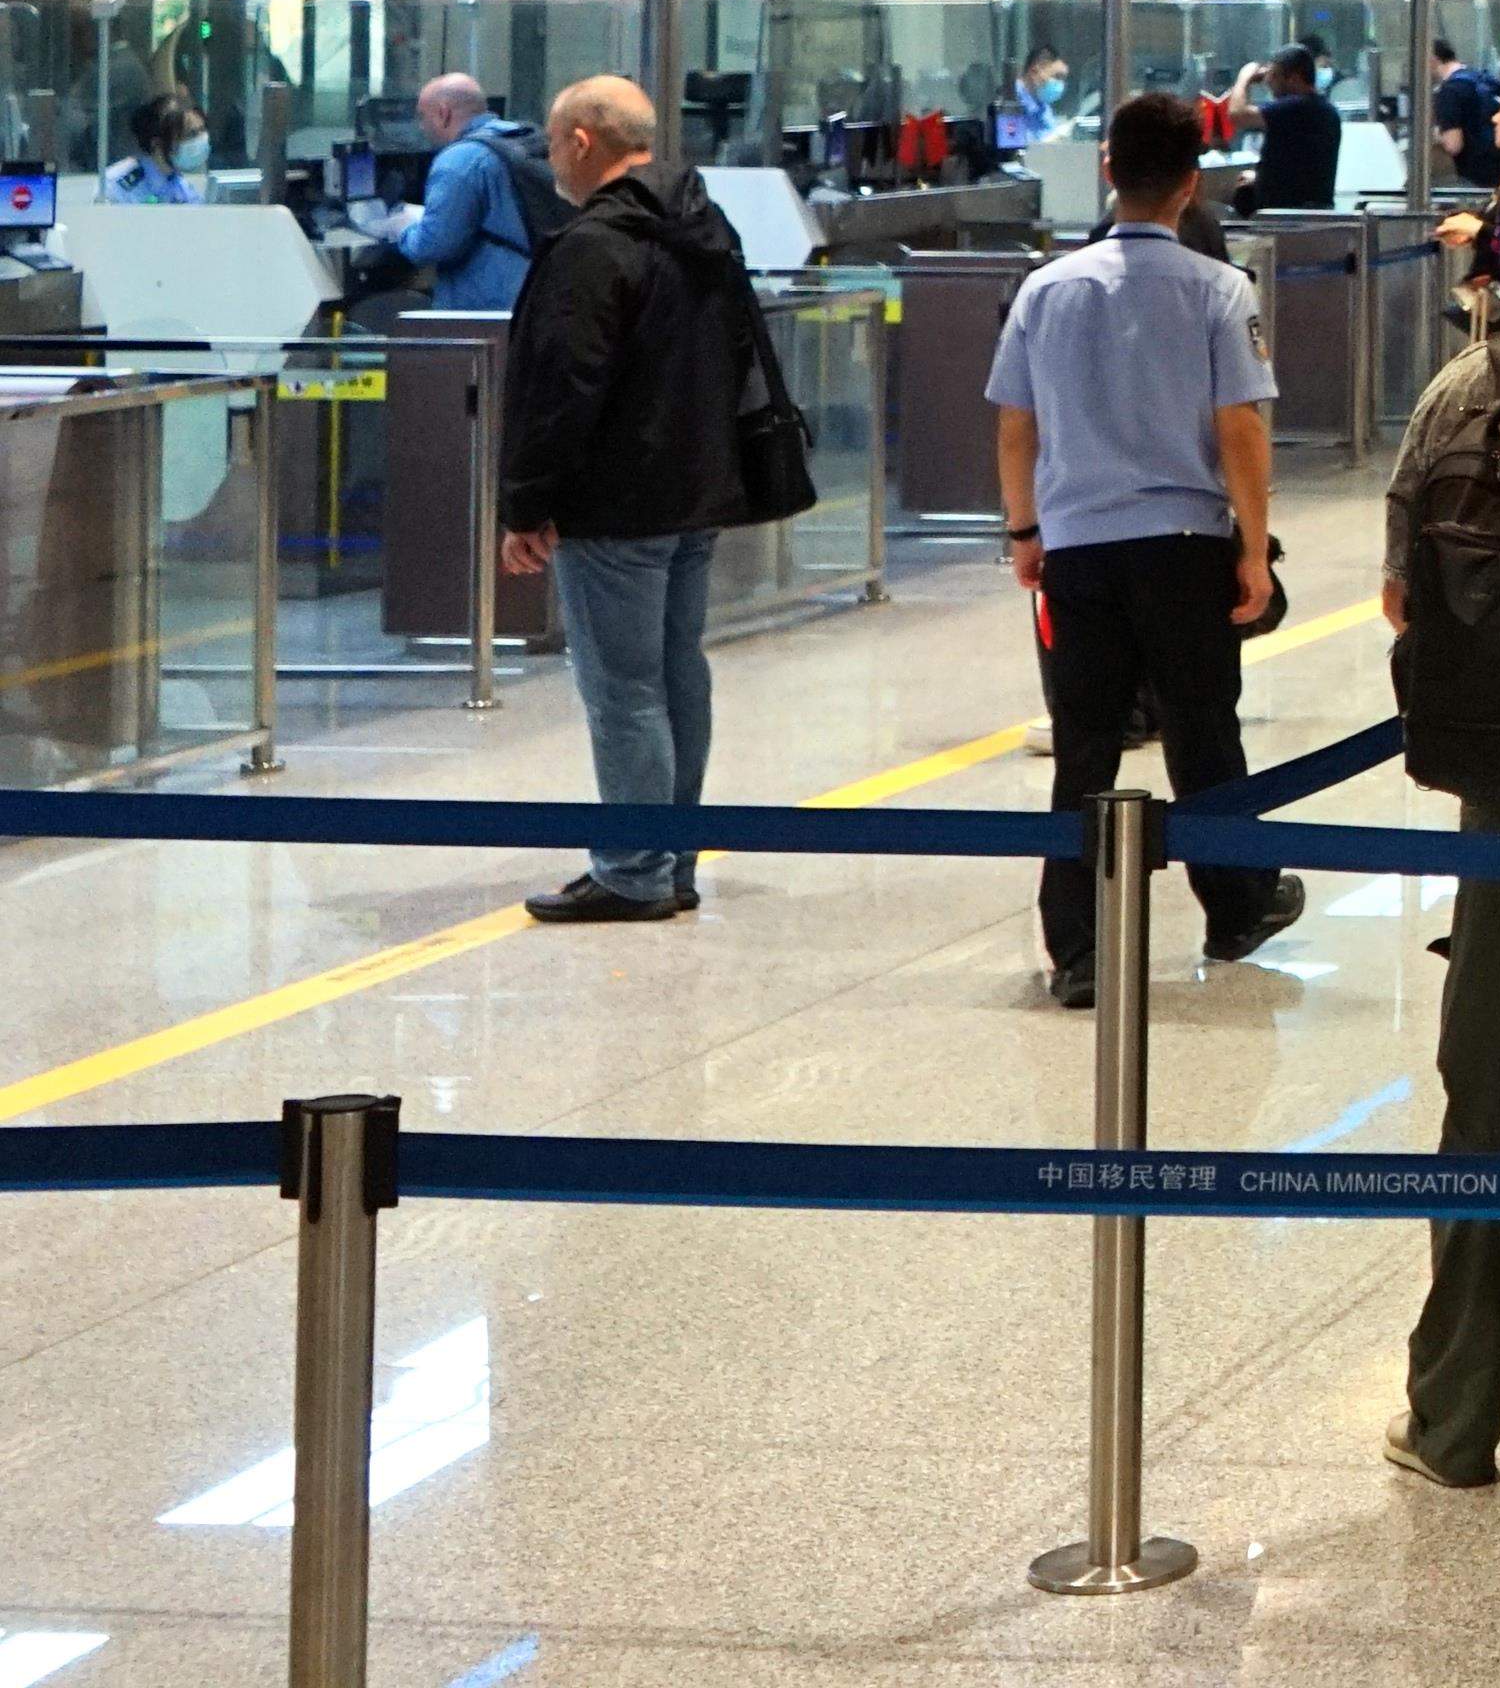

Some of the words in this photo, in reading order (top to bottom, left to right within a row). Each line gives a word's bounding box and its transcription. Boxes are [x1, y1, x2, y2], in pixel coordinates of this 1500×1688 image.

[1038, 1161, 1217, 1191] 中国移民管理
[1239, 1171, 1319, 1193] CHINA
[1326, 1172, 1498, 1195] IMMIGRATION
